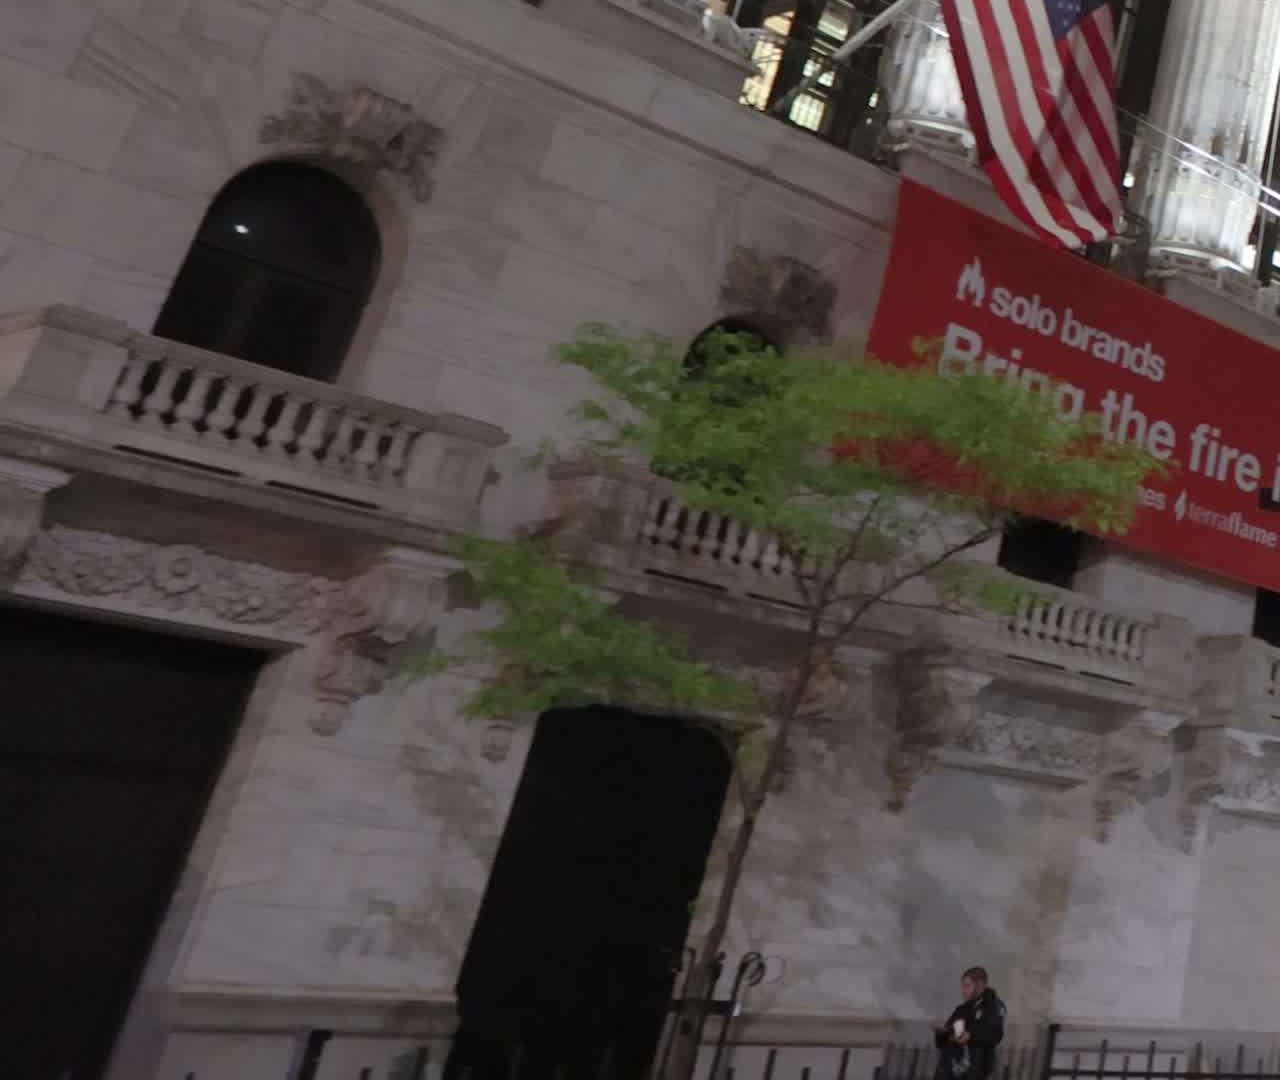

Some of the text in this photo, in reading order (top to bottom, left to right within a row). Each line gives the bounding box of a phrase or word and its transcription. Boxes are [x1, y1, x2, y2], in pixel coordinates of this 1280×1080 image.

[989, 286, 1165, 382] solo brands
[1100, 389, 1176, 461] the
[1189, 423, 1260, 492] fire
[1188, 500, 1278, 548] terraflame
